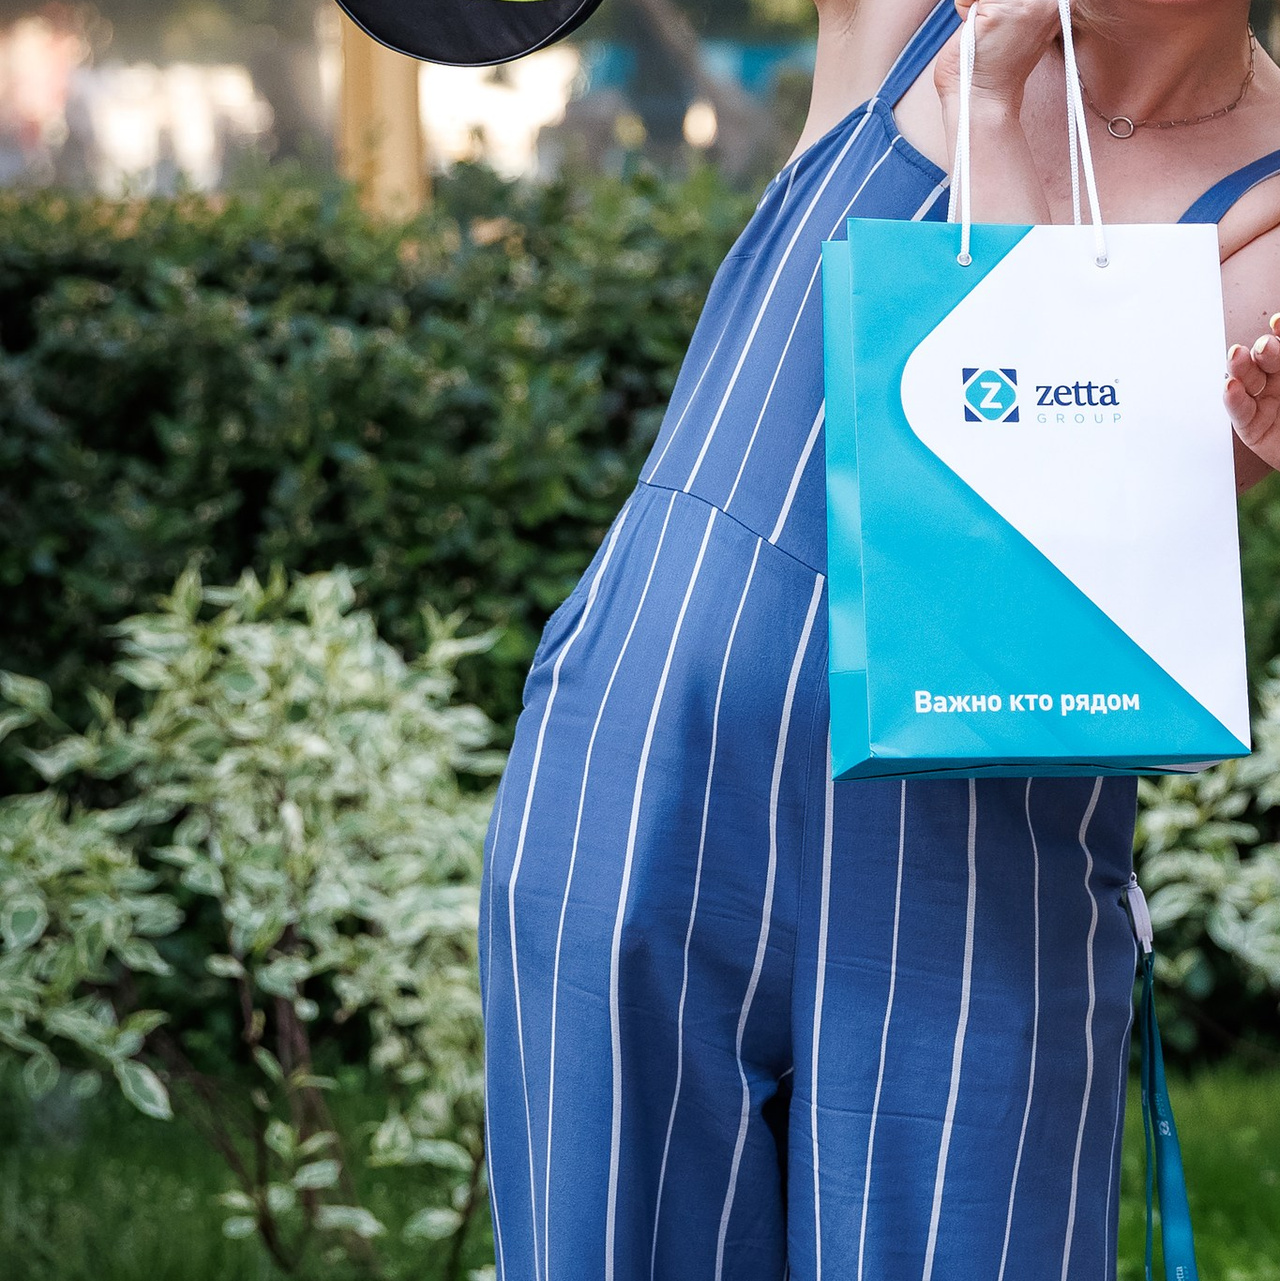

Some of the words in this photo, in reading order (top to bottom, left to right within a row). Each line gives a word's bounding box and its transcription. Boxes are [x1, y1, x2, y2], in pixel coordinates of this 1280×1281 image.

[1035, 380, 1120, 407] zetta
[1036, 413, 1122, 424] GROUP
[914, 690, 1002, 714] Важно
[1009, 694, 1053, 712] кто
[1060, 693, 1140, 716] рядом
